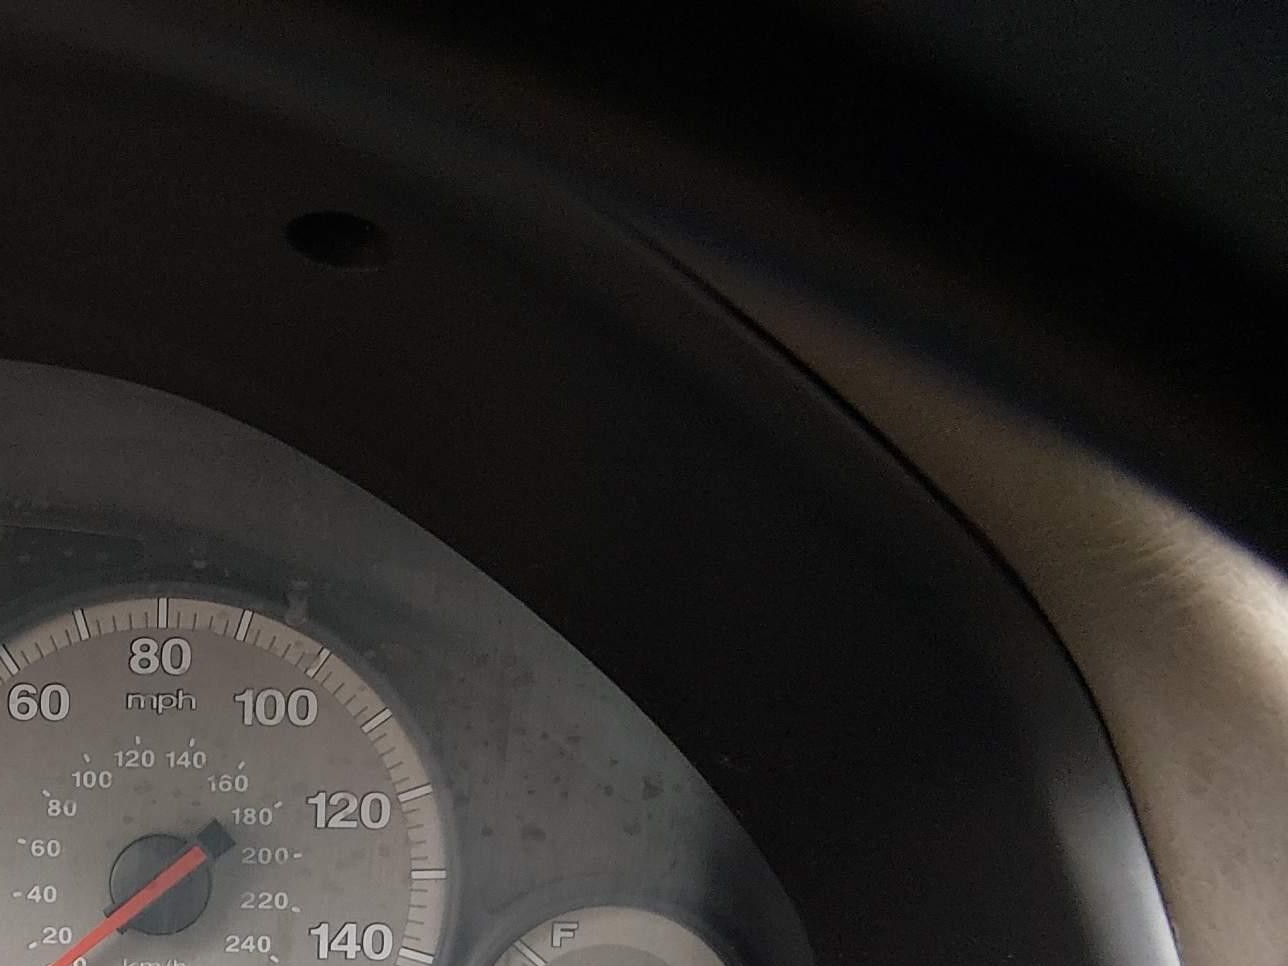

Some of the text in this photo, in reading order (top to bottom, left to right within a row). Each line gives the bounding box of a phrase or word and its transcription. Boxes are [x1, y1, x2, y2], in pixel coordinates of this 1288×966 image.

[128, 637, 192, 675] 80
[8, 683, 71, 721] 60
[126, 691, 197, 714] mph
[234, 688, 319, 726] 100
[114, 749, 155, 768] 120
[166, 750, 207, 769] 140
[72, 770, 112, 790] 100
[208, 774, 249, 793] 160
[47, 800, 77, 818] 80
[231, 807, 273, 825] 180
[307, 791, 391, 829] 120
[30, 839, 61, 857] 60
[242, 847, 289, 865] 200
[27, 885, 57, 903] 40
[241, 892, 289, 910] 220
[42, 927, 72, 945] 20
[225, 935, 271, 953] 240
[309, 923, 393, 960] 140
[551, 922, 578, 947] F
